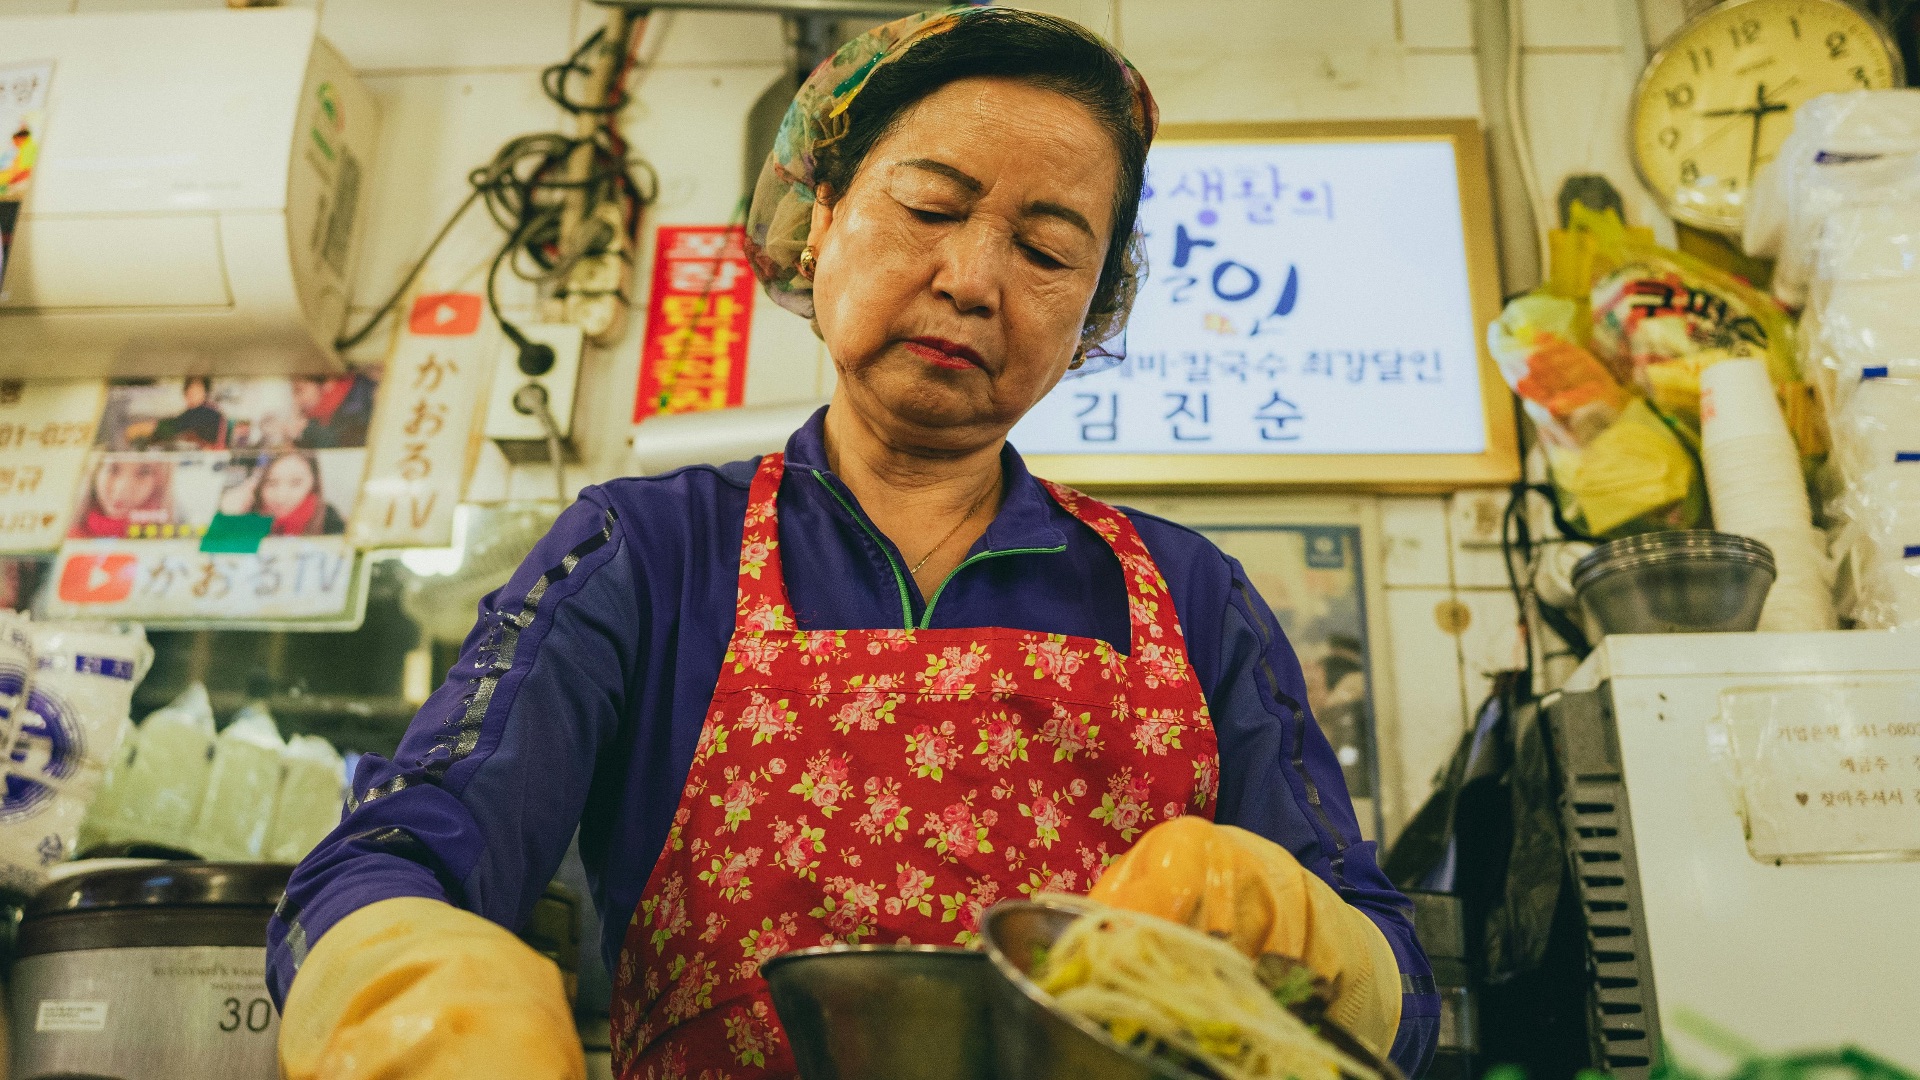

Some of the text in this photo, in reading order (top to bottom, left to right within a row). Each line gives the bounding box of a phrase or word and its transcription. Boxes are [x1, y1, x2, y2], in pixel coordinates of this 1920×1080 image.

[1729, 18, 1761, 50] 12
[1789, 15, 1801, 41] 1
[1687, 48, 1714, 75] 11
[1825, 31, 1847, 60] 2
[1664, 82, 1695, 110] 10
[1658, 126, 1680, 152] 9
[1169, 164, 1336, 226] 생활의
[1302, 350, 1443, 384] 최강달인
[1074, 390, 1304, 441] 김 진 순
[140, 550, 345, 600] かおるTV
[217, 997, 272, 1032] 30
